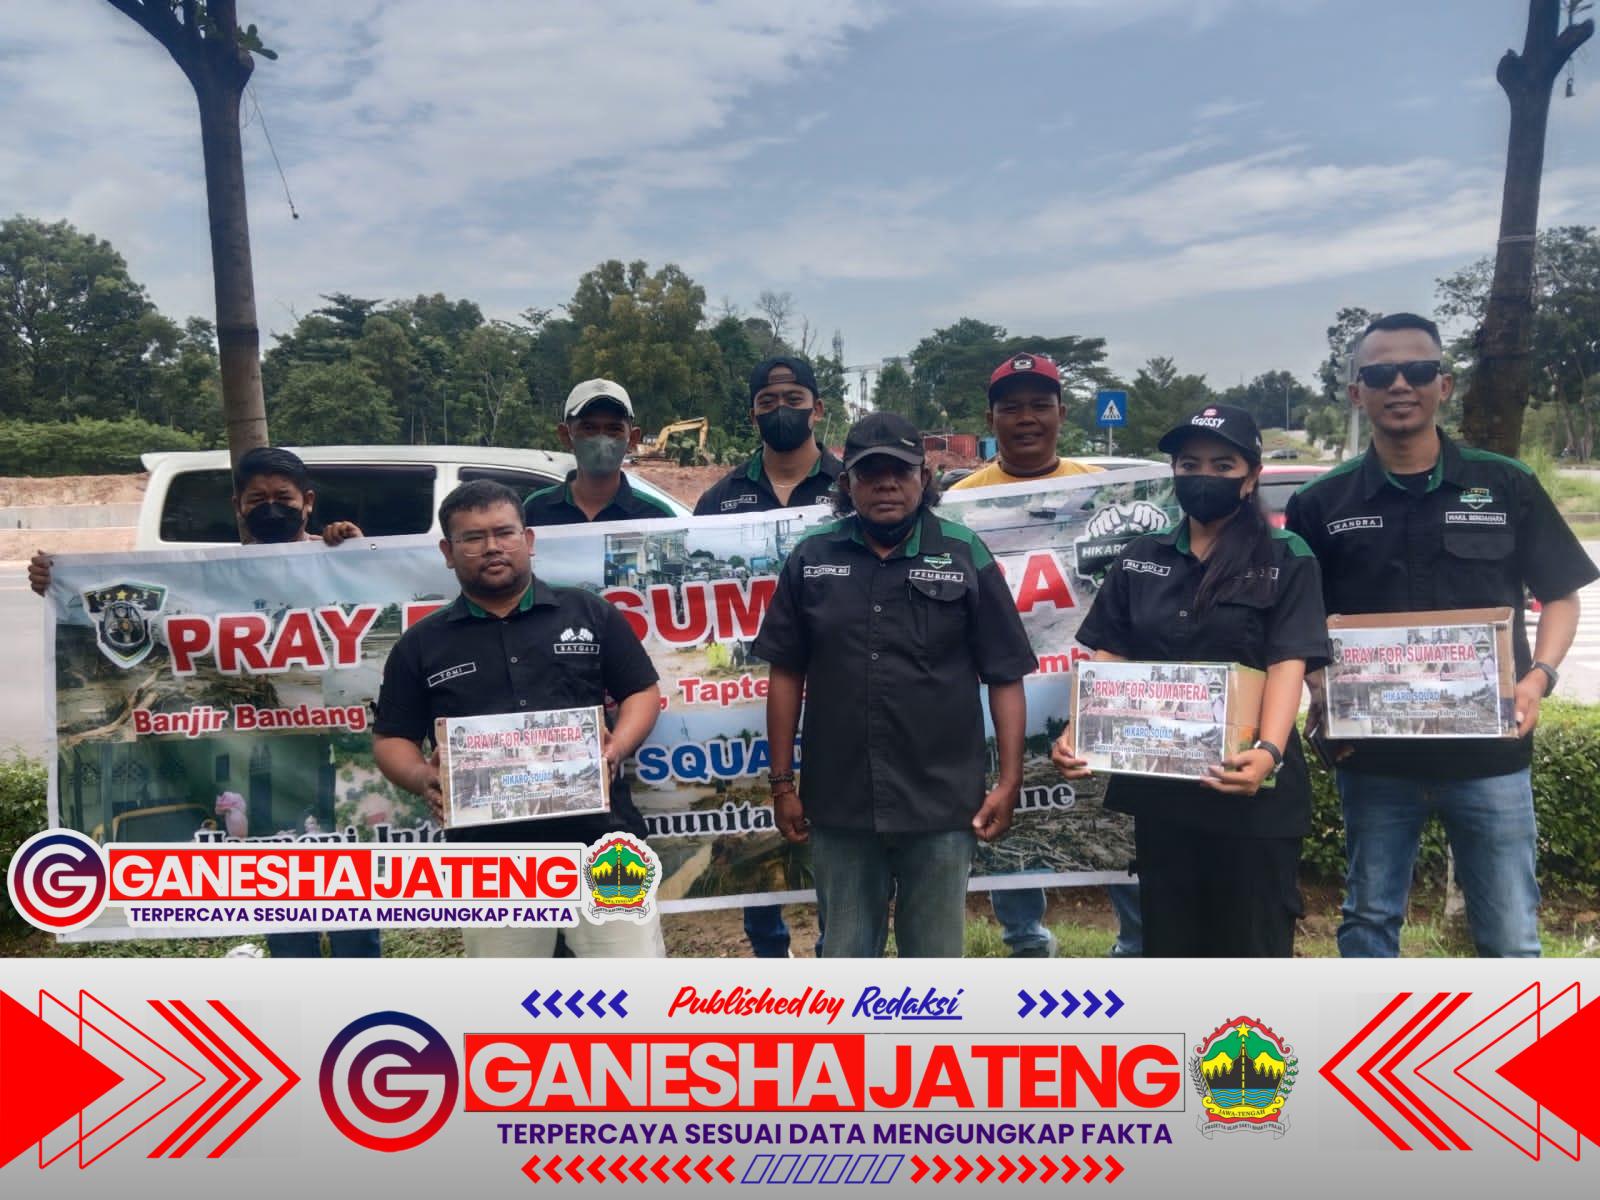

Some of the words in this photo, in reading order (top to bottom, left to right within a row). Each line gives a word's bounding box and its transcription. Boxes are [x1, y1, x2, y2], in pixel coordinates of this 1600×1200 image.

[1333, 519, 1377, 531] WANDRA
[1081, 543, 1127, 558] HIKAR
[166, 606, 379, 674] PRAY
[1343, 647, 1377, 664] PRAY
[1379, 646, 1405, 663] FOR
[1406, 643, 1476, 663] SUMATERA
[439, 668, 463, 679] TOMI
[1094, 680, 1123, 698] PRAY
[1124, 681, 1145, 699] FOR
[1148, 682, 1209, 701] SUMATERA
[133, 705, 228, 737] Banjir
[235, 703, 367, 732] Bandang
[466, 732, 498, 749] PRAY
[499, 730, 521, 748] FOR
[523, 726, 583, 746] SUMATERA
